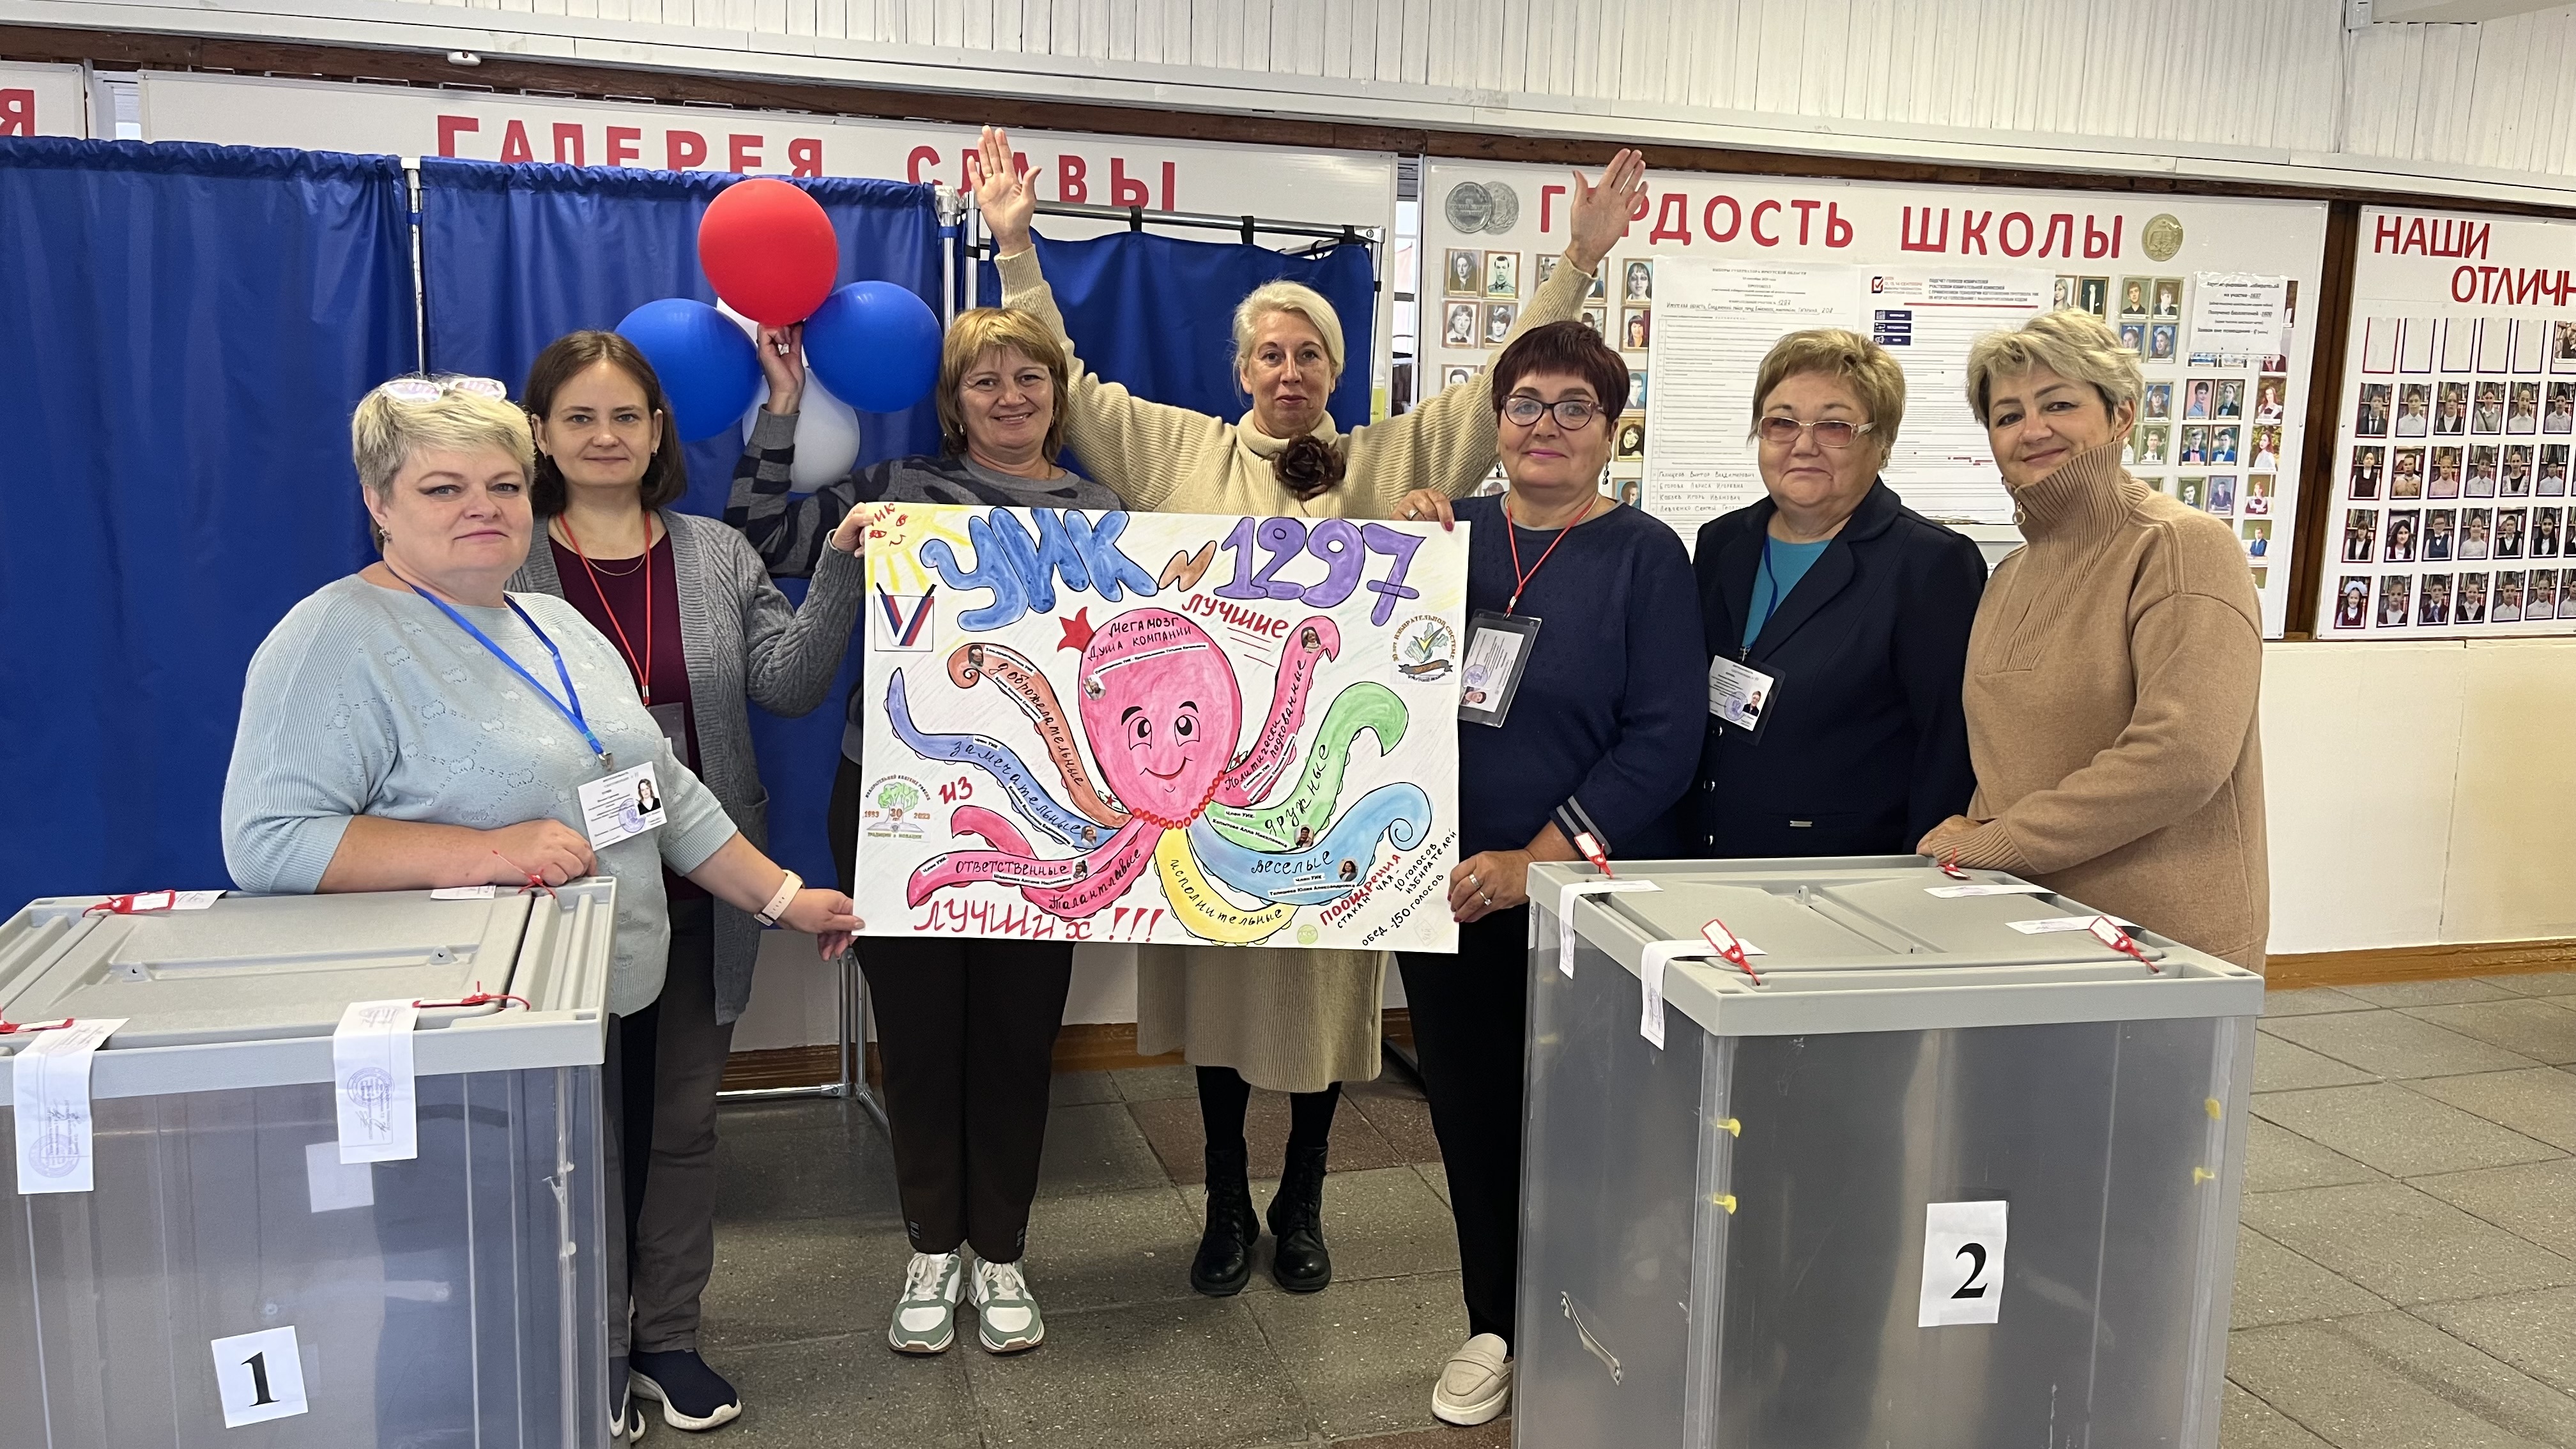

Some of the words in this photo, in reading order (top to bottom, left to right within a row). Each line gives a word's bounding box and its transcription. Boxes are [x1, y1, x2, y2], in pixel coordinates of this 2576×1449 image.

[437, 114, 822, 178] ГАЛЕРЕЯ
[1540, 185, 1853, 247] ГРДОСТЬ
[1901, 205, 2123, 259] ШКОЛЫ
[2374, 215, 2490, 259] НАШИ
[871, 502, 895, 526] ИК
[920, 506, 1158, 631] УИК
[1213, 516, 1427, 627] 1297
[1132, 625, 1192, 647] КОМПАНИИ
[1170, 859, 1283, 926] исполнительные
[1394, 878, 1406, 893] 10
[1405, 843, 1438, 880] ГОЛОСОВ
[1410, 874, 1445, 910] ГОЛОСОВ
[1337, 895, 1371, 929] СТАКАН
[1376, 875, 1394, 892] ЧАЯ
[1950, 1242, 1988, 1300] 2
[241, 1351, 280, 1408] 1
